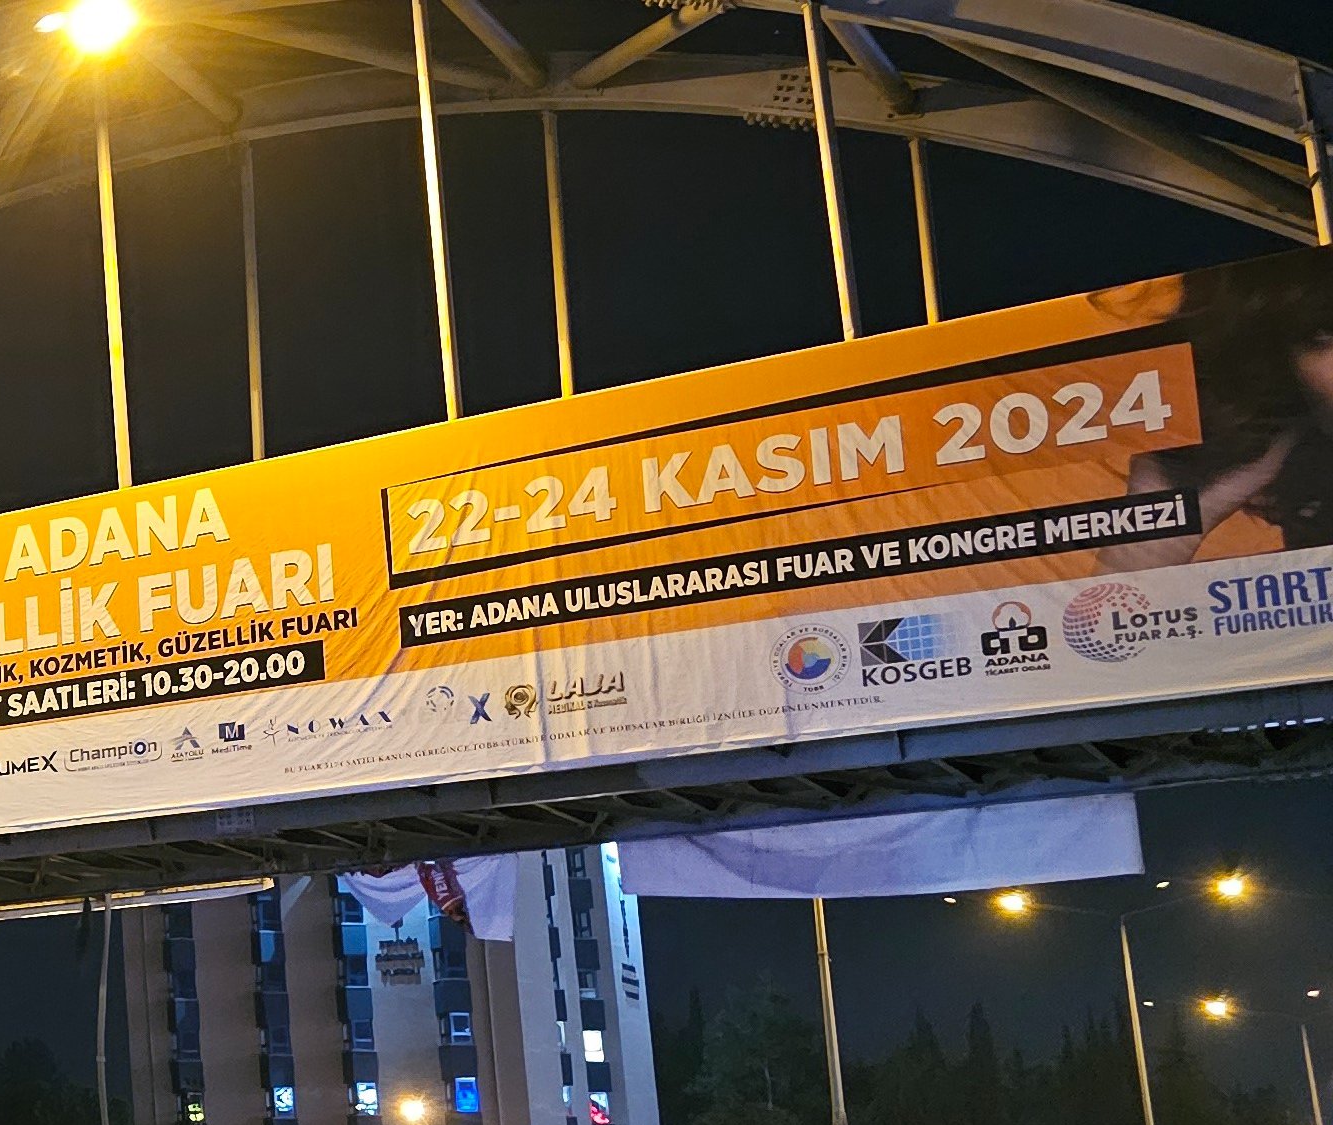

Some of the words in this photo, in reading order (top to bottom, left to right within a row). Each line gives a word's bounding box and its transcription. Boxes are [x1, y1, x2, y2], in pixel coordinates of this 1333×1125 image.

[407, 466, 617, 556] 22-24
[643, 414, 906, 513] KASIM
[934, 369, 1172, 466] 2024
[4, 487, 232, 581] ADANA
[409, 607, 465, 638] YER:
[470, 591, 558, 628] ADANA
[564, 560, 769, 617] ULUSLARARASI
[777, 547, 853, 583] FUAR
[862, 541, 902, 570] VE
[909, 522, 1036, 565] KONGRE
[1044, 491, 1187, 544] MERKEZİ
[139, 543, 336, 633] FUARI
[1208, 567, 1332, 614] START
[30, 646, 153, 679] KOZMETİK,
[158, 622, 275, 662] GÜZELLİK
[281, 609, 359, 640] FUARI
[985, 653, 1049, 668] ADANA
[1115, 628, 1162, 645] FUAR
[8, 676, 137, 720] SAATLERİ:
[142, 651, 305, 699] 10.30-20.00
[862, 657, 973, 687] KOSGEB
